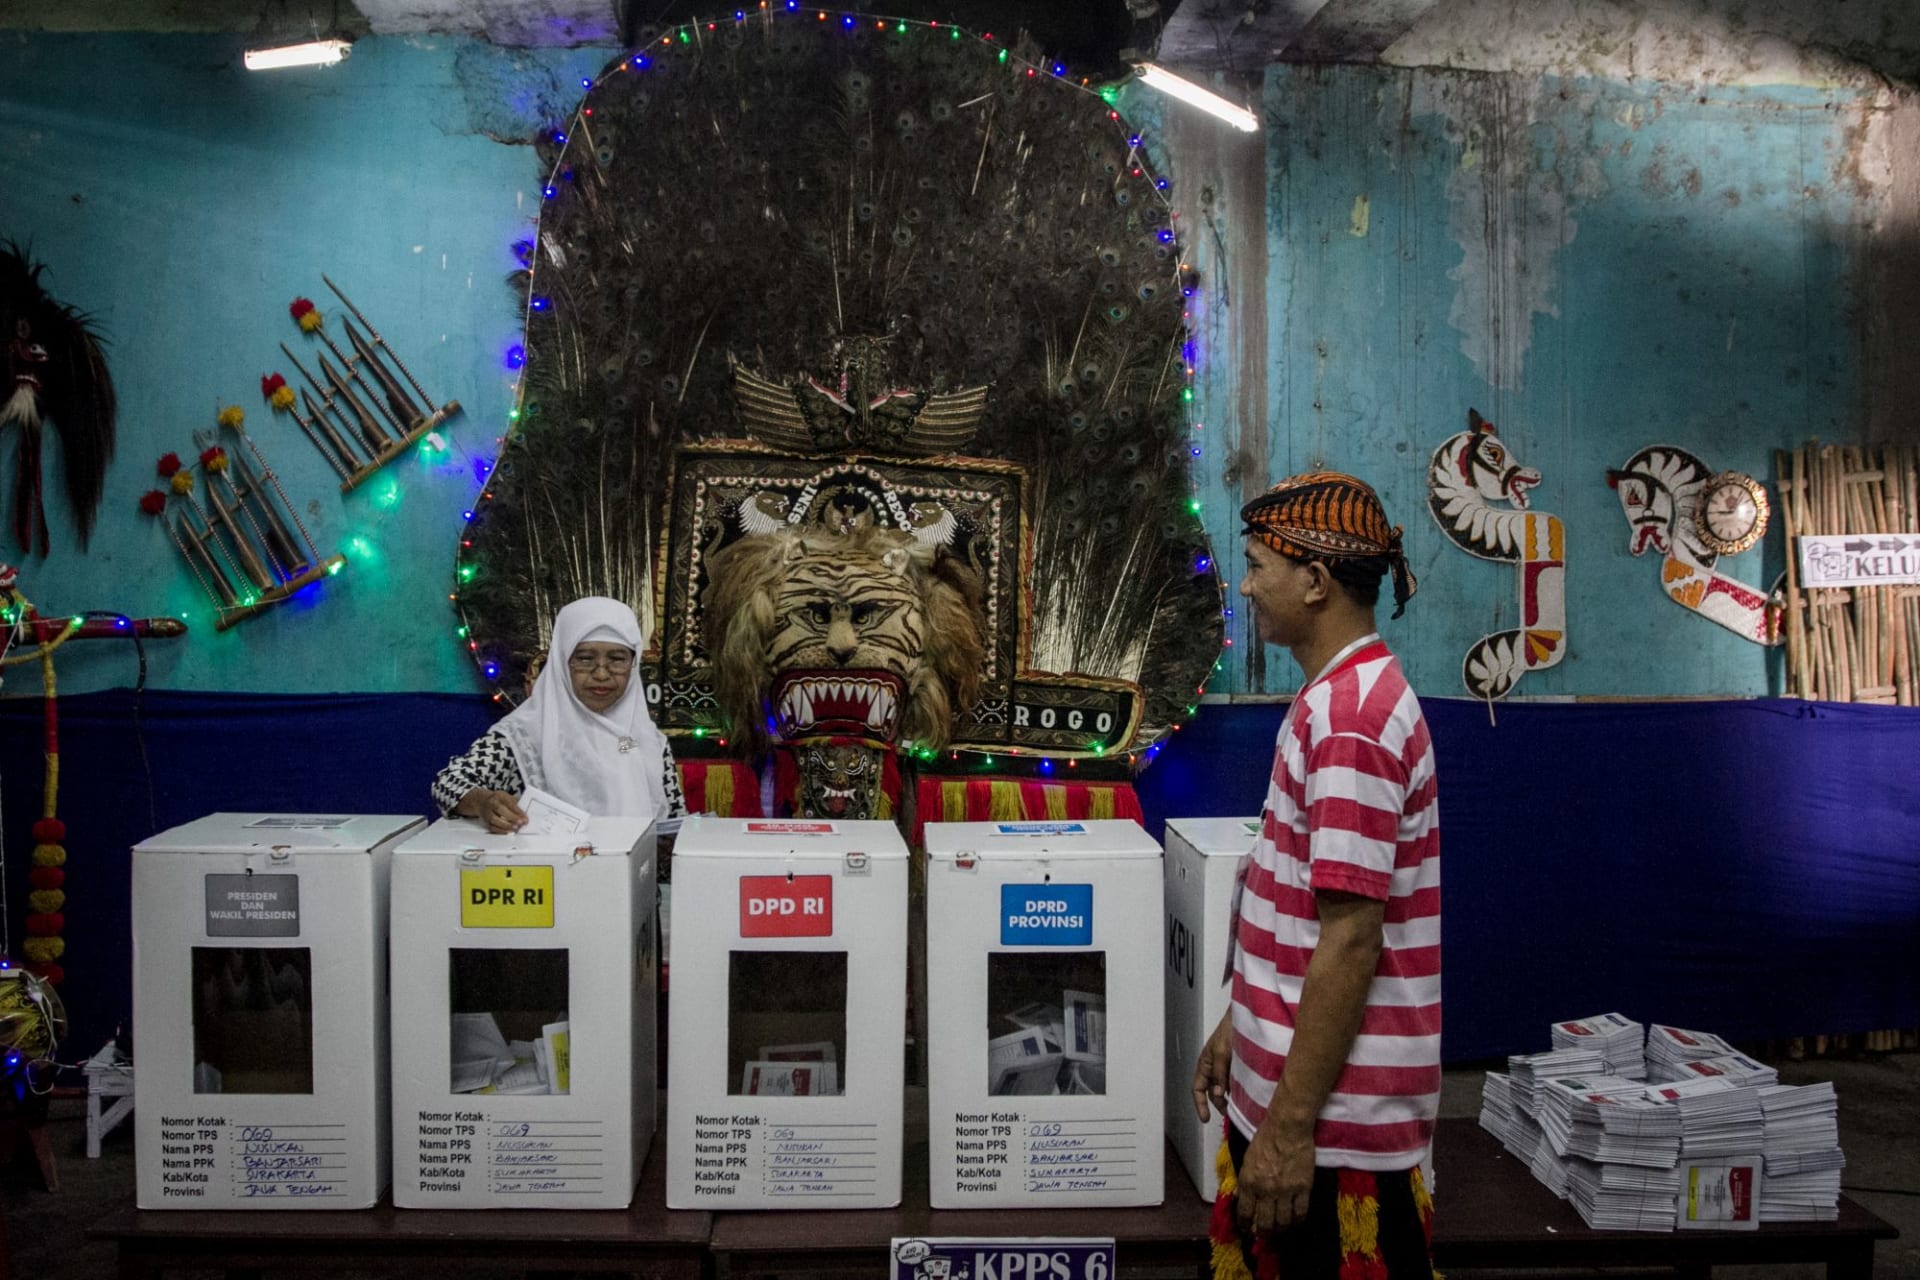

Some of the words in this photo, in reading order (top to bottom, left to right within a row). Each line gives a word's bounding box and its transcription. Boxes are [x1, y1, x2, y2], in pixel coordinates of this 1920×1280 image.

[787, 484, 818, 524] SENI
[883, 490, 912, 532] REOG
[1855, 554, 1920, 577] KELU
[1013, 705, 1112, 732] ROGO
[227, 892, 277, 900] PRESIDEN
[472, 889, 515, 905] DPR
[524, 889, 543, 905] RI
[241, 902, 264, 910] DAN
[749, 898, 795, 915] DPD
[804, 898, 823, 914] RI
[1026, 901, 1067, 913] DPRD
[210, 911, 242, 919] WAKIL
[246, 911, 296, 919] PRESIDEN
[1009, 916, 1083, 928] PROVINSI
[1170, 913, 1194, 989] KPU
[419, 1112, 452, 1121] Nomor
[455, 1112, 484, 1121] Kotak
[696, 1116, 728, 1125] Nomor
[732, 1115, 760, 1125] Kotak
[956, 1113, 988, 1122] Nomor
[991, 1113, 1019, 1121] Kotak
[162, 1117, 194, 1126] Nomor
[198, 1117, 226, 1126] Kotak
[419, 1126, 452, 1135] Nomor
[455, 1125, 475, 1135] TPS
[696, 1130, 728, 1139] Nomor
[731, 1130, 751, 1139] TPS
[956, 1127, 988, 1136] Nomor
[992, 1127, 1011, 1136] TPS
[1031, 1124, 1062, 1136] 069
[162, 1131, 195, 1140] Nomor
[198, 1131, 217, 1140] TPS
[419, 1140, 447, 1149] Nama
[450, 1140, 471, 1148] PPS
[696, 1144, 723, 1153] Nama
[726, 1144, 746, 1152] PPS
[956, 1141, 984, 1150] Nama
[987, 1141, 1007, 1149] PPS
[163, 1145, 190, 1154] Nama
[193, 1145, 214, 1154] PPS
[420, 1154, 447, 1163] Nama
[450, 1154, 471, 1163] PPK
[696, 1158, 723, 1167] Nama
[726, 1158, 747, 1167] PPK
[956, 1155, 984, 1164] Nama
[987, 1155, 1007, 1163] PPK
[163, 1159, 190, 1168] Nama
[194, 1159, 215, 1168] PPK
[420, 1167, 465, 1177] Kab/Kota
[695, 1171, 740, 1181] Kab/Kota
[957, 1168, 1001, 1178] Kab/Kota
[163, 1173, 208, 1182] Kab/Kota
[420, 1182, 460, 1191] Provinsi
[695, 1185, 735, 1195] Provinsi
[957, 1183, 997, 1191] Provinsi
[164, 1187, 204, 1196] Provinsi
[975, 1252, 1071, 1280] KPPS
[1084, 1252, 1108, 1280] 6
